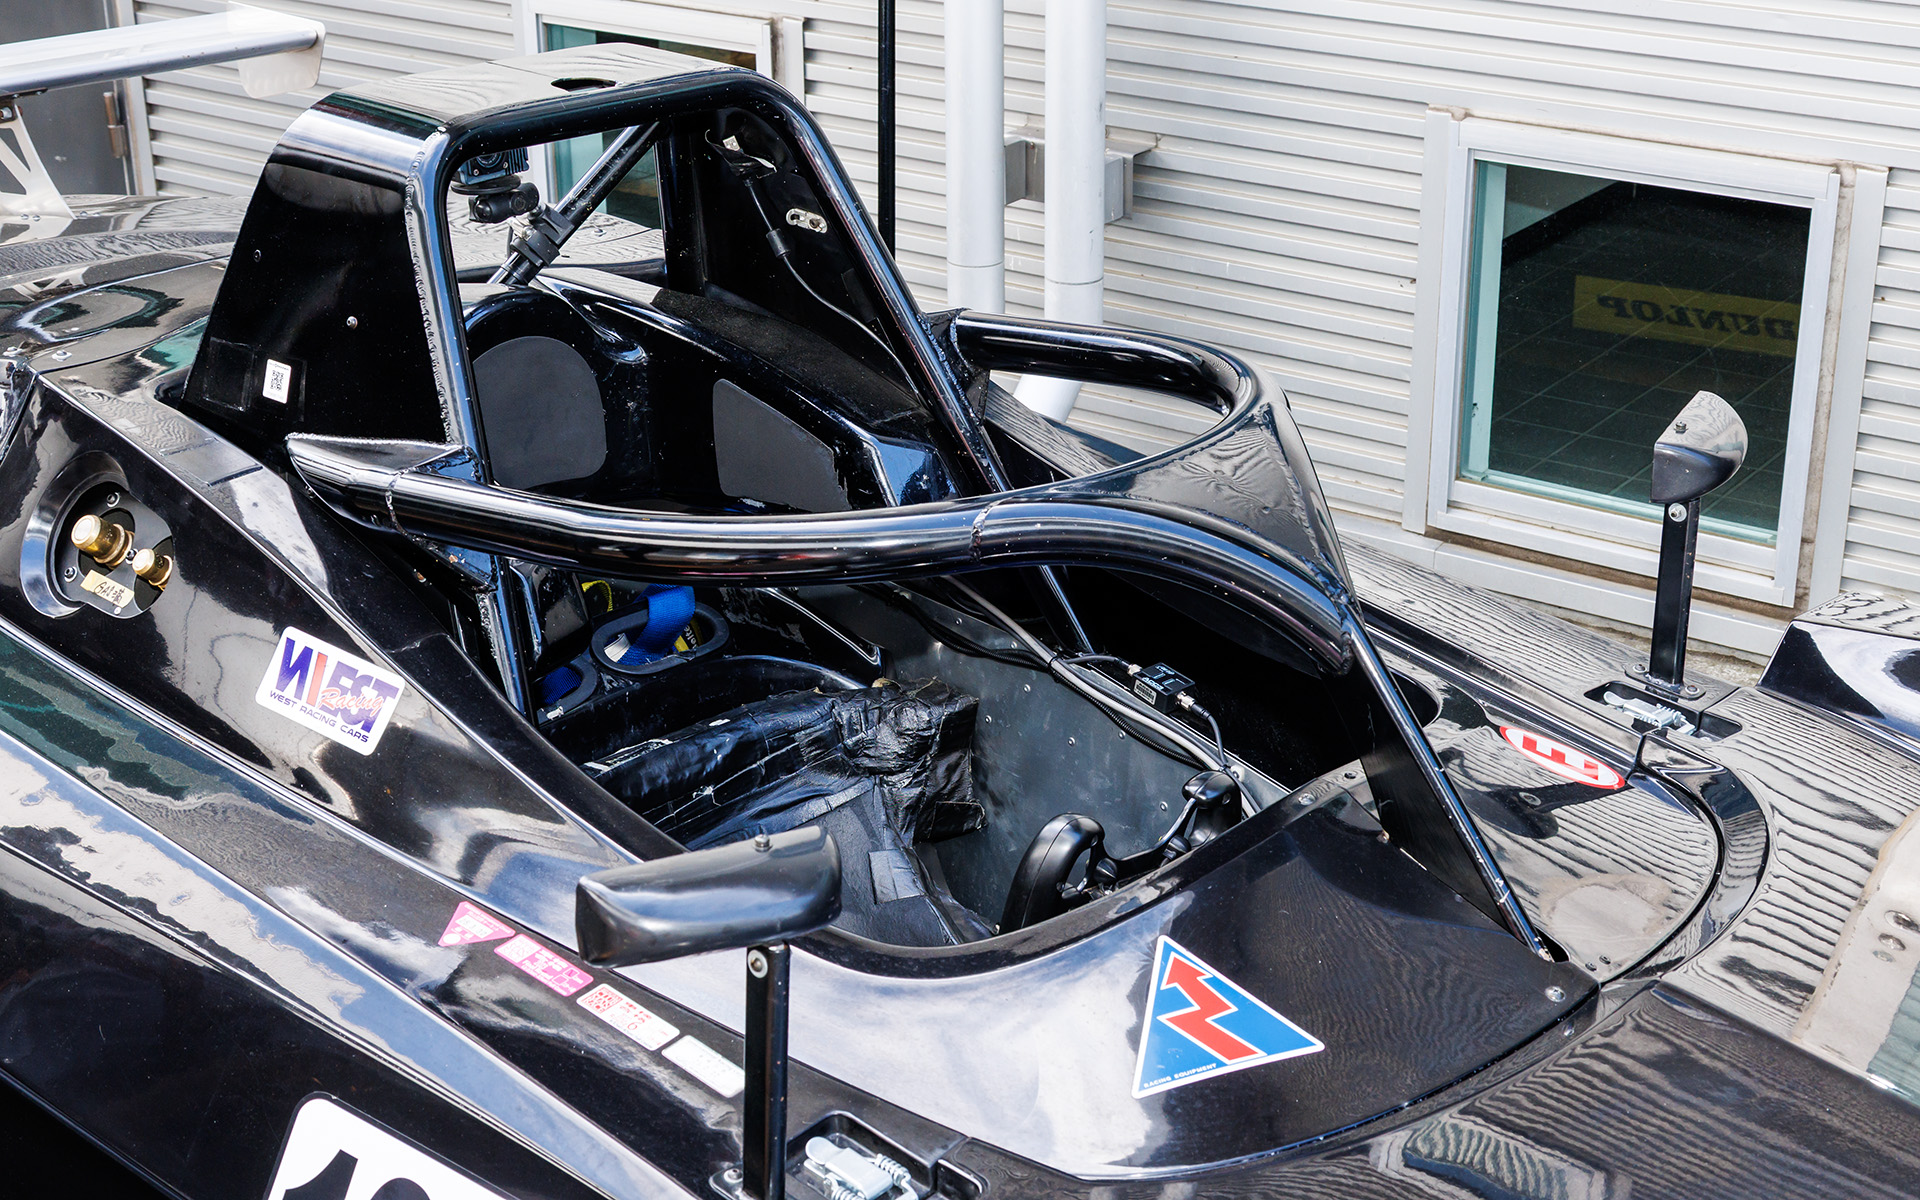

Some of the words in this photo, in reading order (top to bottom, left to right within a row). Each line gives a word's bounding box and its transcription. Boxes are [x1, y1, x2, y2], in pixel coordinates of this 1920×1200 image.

[318, 687, 383, 716] Racing
[270, 690, 297, 708] WEST
[300, 705, 337, 727] RACING
[340, 724, 369, 743] CARS
[1143, 1076, 1172, 1089] RACING
[1174, 1063, 1217, 1079] EQUIPMENT
